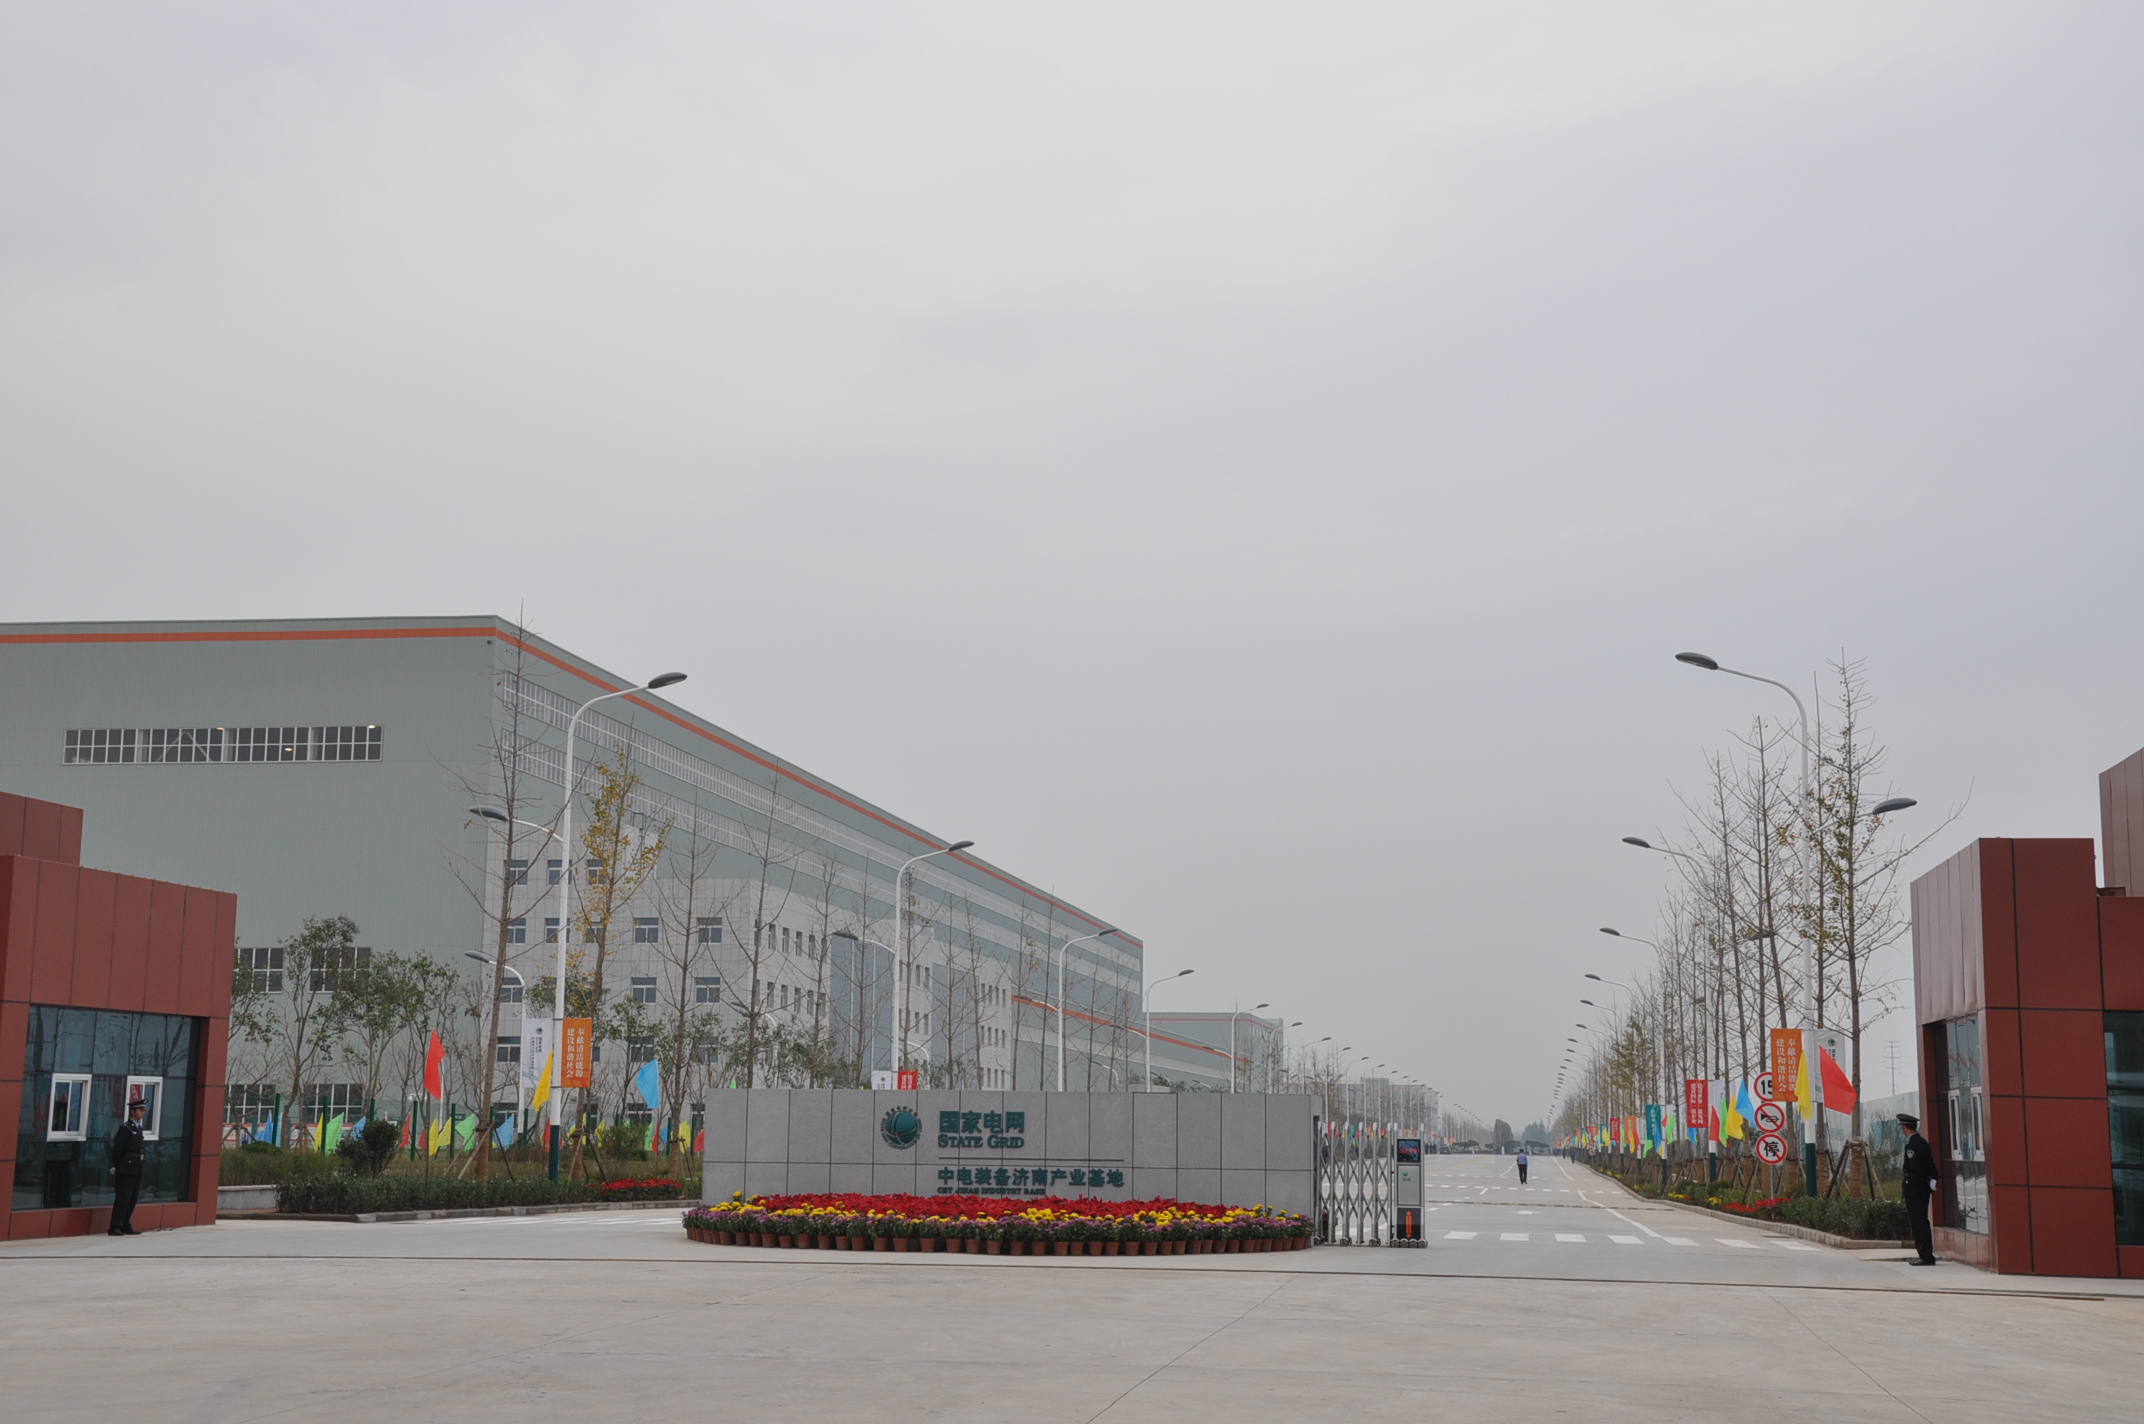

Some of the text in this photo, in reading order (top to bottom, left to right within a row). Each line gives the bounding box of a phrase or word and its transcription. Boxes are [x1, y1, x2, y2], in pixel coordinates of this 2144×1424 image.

[566, 1028, 575, 1078] 建设和谐社会
[575, 1028, 585, 1078] 奉献清洁能源
[1776, 1038, 1787, 1092] 建设和谐社会
[1787, 1038, 1797, 1091] 奉献清洁能源
[938, 1110, 1025, 1134] 国家电网
[937, 1133, 1025, 1149] STATE GRID
[1763, 1140, 1780, 1157] 停
[937, 1166, 1125, 1187] 中电装备济南产业基地
